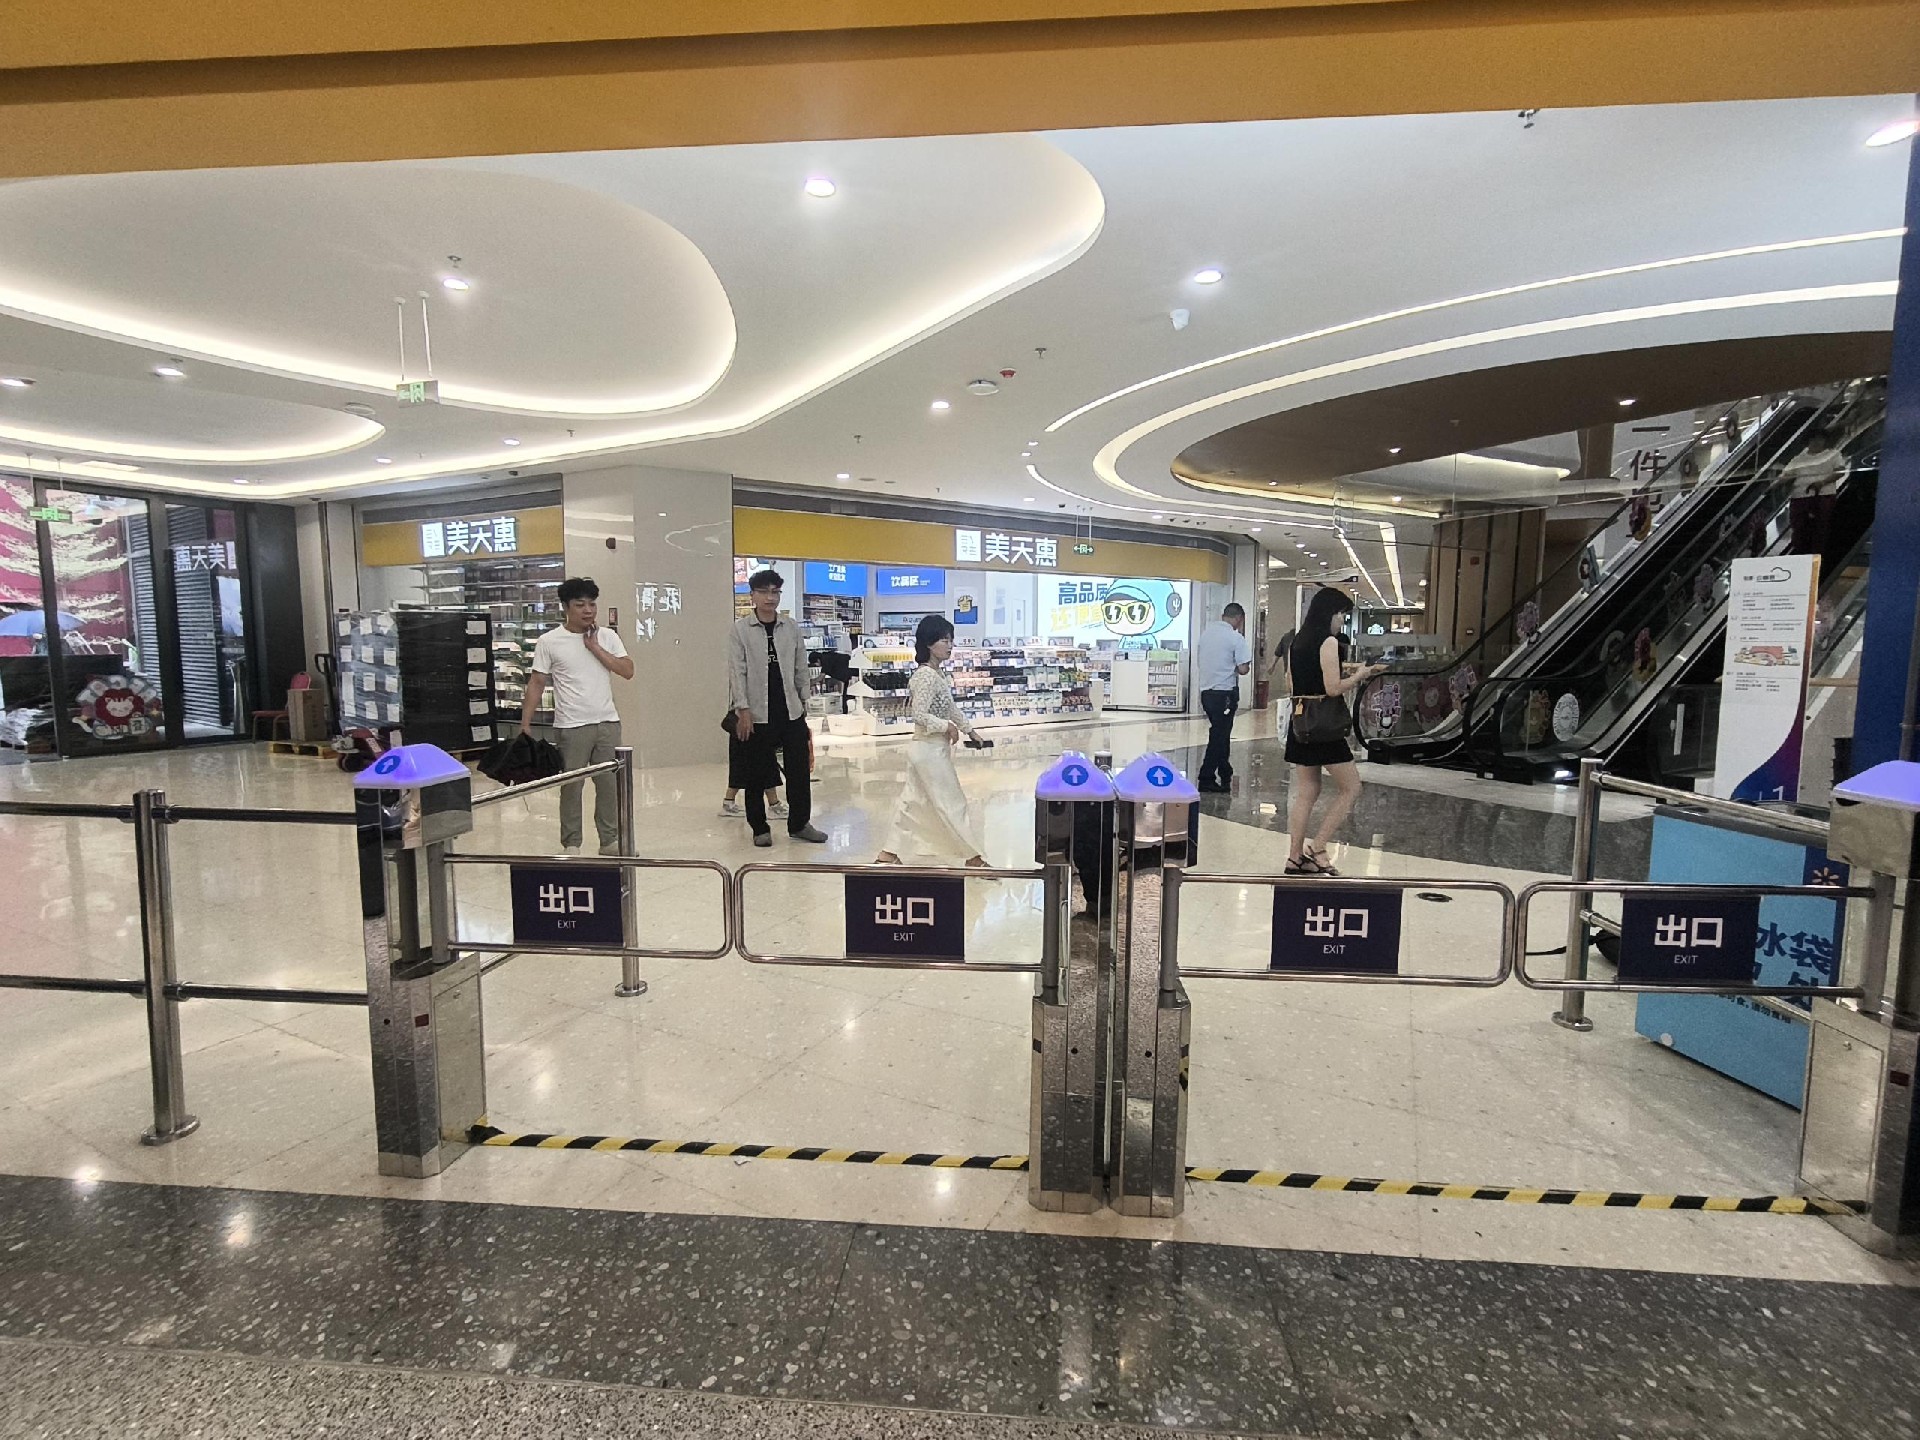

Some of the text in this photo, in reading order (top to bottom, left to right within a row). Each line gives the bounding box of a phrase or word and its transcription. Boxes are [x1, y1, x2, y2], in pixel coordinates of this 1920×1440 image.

[446, 516, 517, 555] 美天惠
[984, 532, 1058, 567] 美天惠
[1058, 582, 1108, 606] 高品质
[539, 884, 595, 914] 出口
[875, 893, 934, 926] 出口
[557, 920, 577, 929] EXIT
[1304, 905, 1369, 938] 出口
[1654, 914, 1723, 948] 出口
[893, 932, 915, 942] EXIT
[1323, 944, 1346, 954] EXIT
[1674, 954, 1698, 965] EXIT
